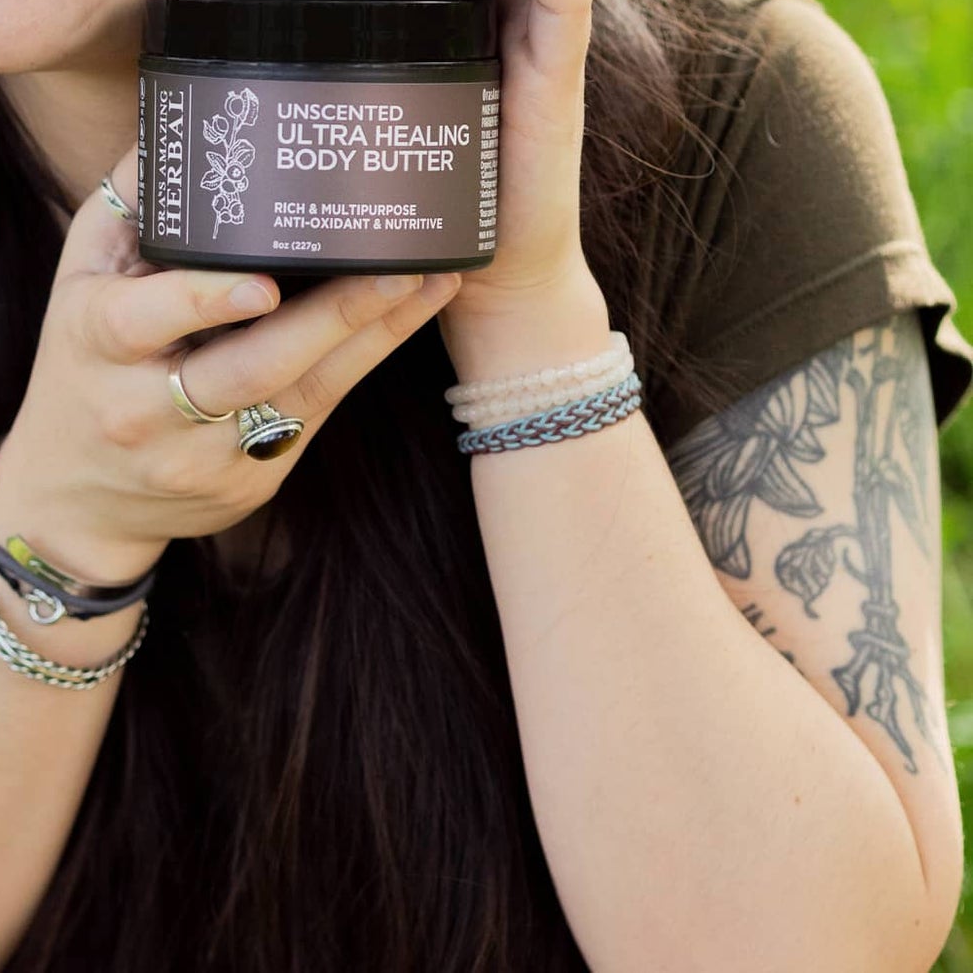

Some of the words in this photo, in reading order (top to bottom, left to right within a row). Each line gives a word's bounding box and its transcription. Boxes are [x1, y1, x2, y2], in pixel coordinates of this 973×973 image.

[277, 103, 403, 121] UNSCENTED
[158, 90, 168, 179] AMAZING
[277, 123, 367, 145] ULTRA
[375, 124, 470, 147] HEALING
[166, 90, 185, 238] HERBAL
[276, 149, 358, 171] BODY
[363, 150, 454, 172] BUTTER
[157, 181, 166, 236] ORA'S
[274, 203, 306, 215] RICH
[308, 203, 317, 215] &
[321, 203, 417, 216] MULTIPURPOSE
[274, 217, 371, 229] ANTI-OXIDANT
[373, 218, 382, 229] &
[385, 218, 443, 230] NUTRITIVE
[273, 240, 290, 250] 8oz
[291, 240, 321, 252] (227g)
